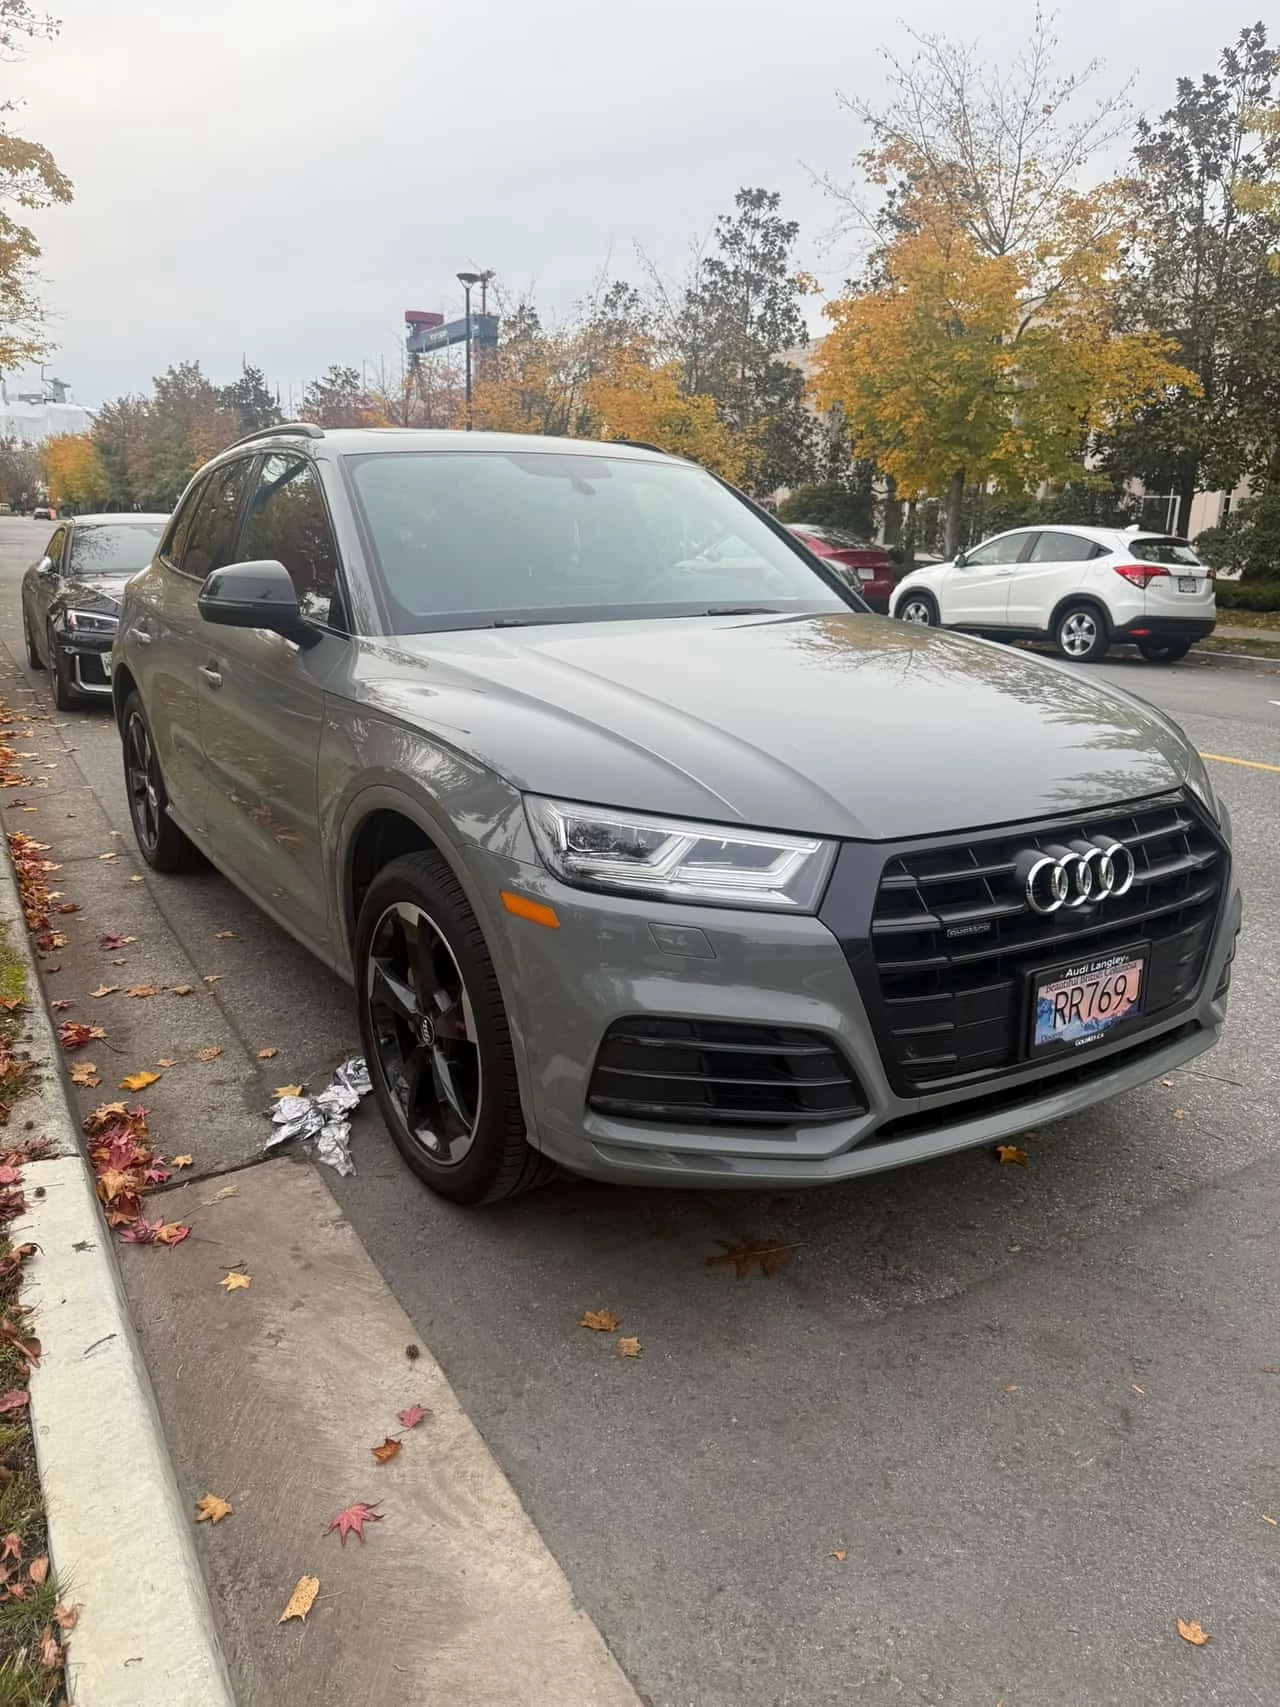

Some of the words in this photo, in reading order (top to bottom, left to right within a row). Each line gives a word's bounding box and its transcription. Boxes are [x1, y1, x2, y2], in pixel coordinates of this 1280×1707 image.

[1065, 964, 1089, 979] Audi
[1090, 954, 1126, 972] Langley
[1053, 968, 1141, 1029] RR769J
